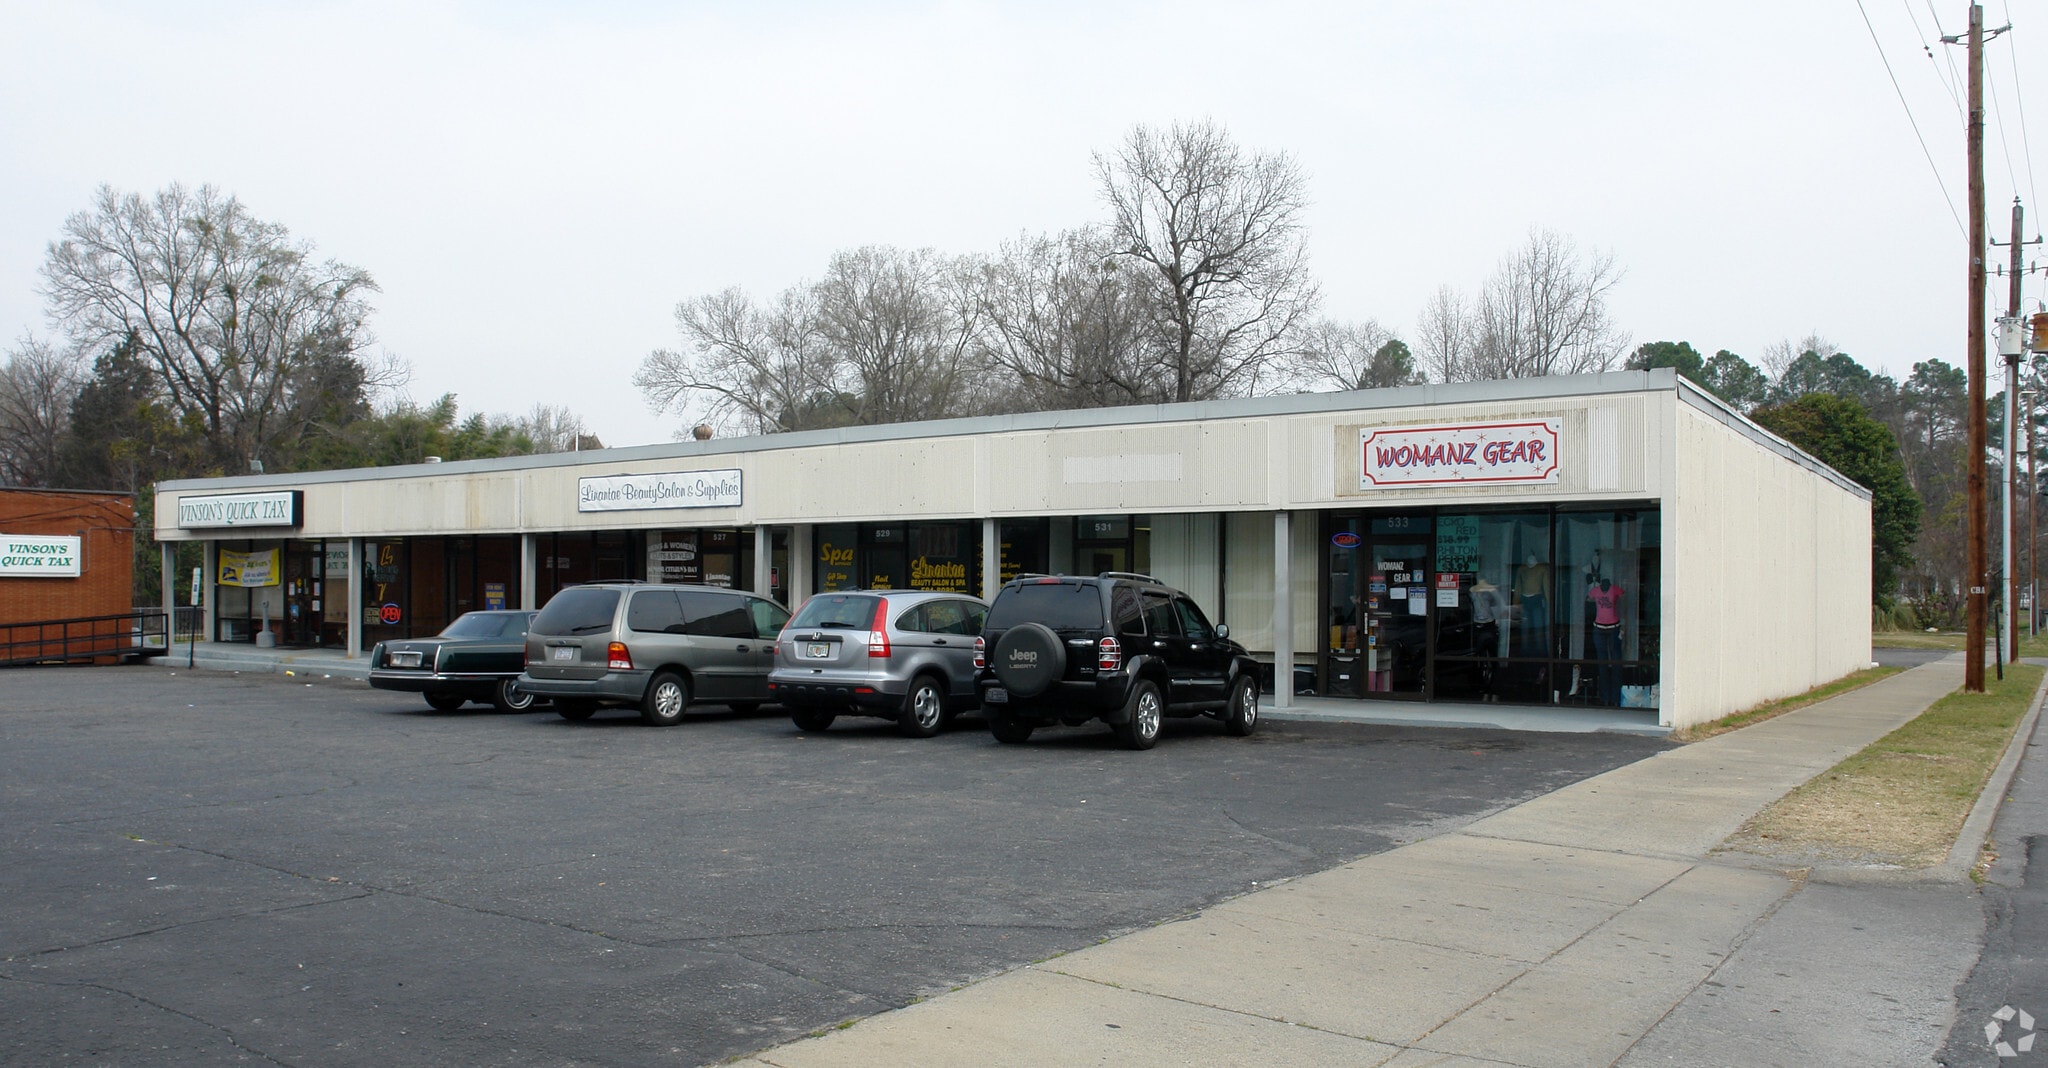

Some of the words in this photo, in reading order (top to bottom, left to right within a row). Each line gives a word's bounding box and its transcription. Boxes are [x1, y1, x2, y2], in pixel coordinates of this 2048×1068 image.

[1376, 442, 1477, 468] WOMANZ
[1482, 439, 1546, 466] GEAR
[695, 479, 738, 501] Supplies
[181, 501, 224, 522] VINSON'S
[226, 501, 259, 524] QUICK
[263, 500, 287, 518] TAX
[1388, 517, 1409, 528] 533
[1438, 517, 1465, 526] ECKO
[1095, 523, 1112, 531] 531
[1456, 526, 1477, 535] RED
[713, 533, 726, 541] 527
[876, 530, 890, 538] 529
[9, 544, 68, 554] VINSON'S
[820, 543, 854, 566] Spa
[1, 556, 44, 567] QUICK
[47, 557, 73, 566] TAX
[1377, 561, 1404, 571] WOMANZ
[874, 575, 889, 583] Nail
[911, 579, 931, 587] BEAUTY
[931, 579, 949, 587] SALON
[955, 579, 966, 587] SPA
[1394, 573, 1411, 583] GEAR
[1441, 574, 1453, 582] HELP
[380, 607, 401, 621] OPEN
[1009, 649, 1037, 663] Jeep
